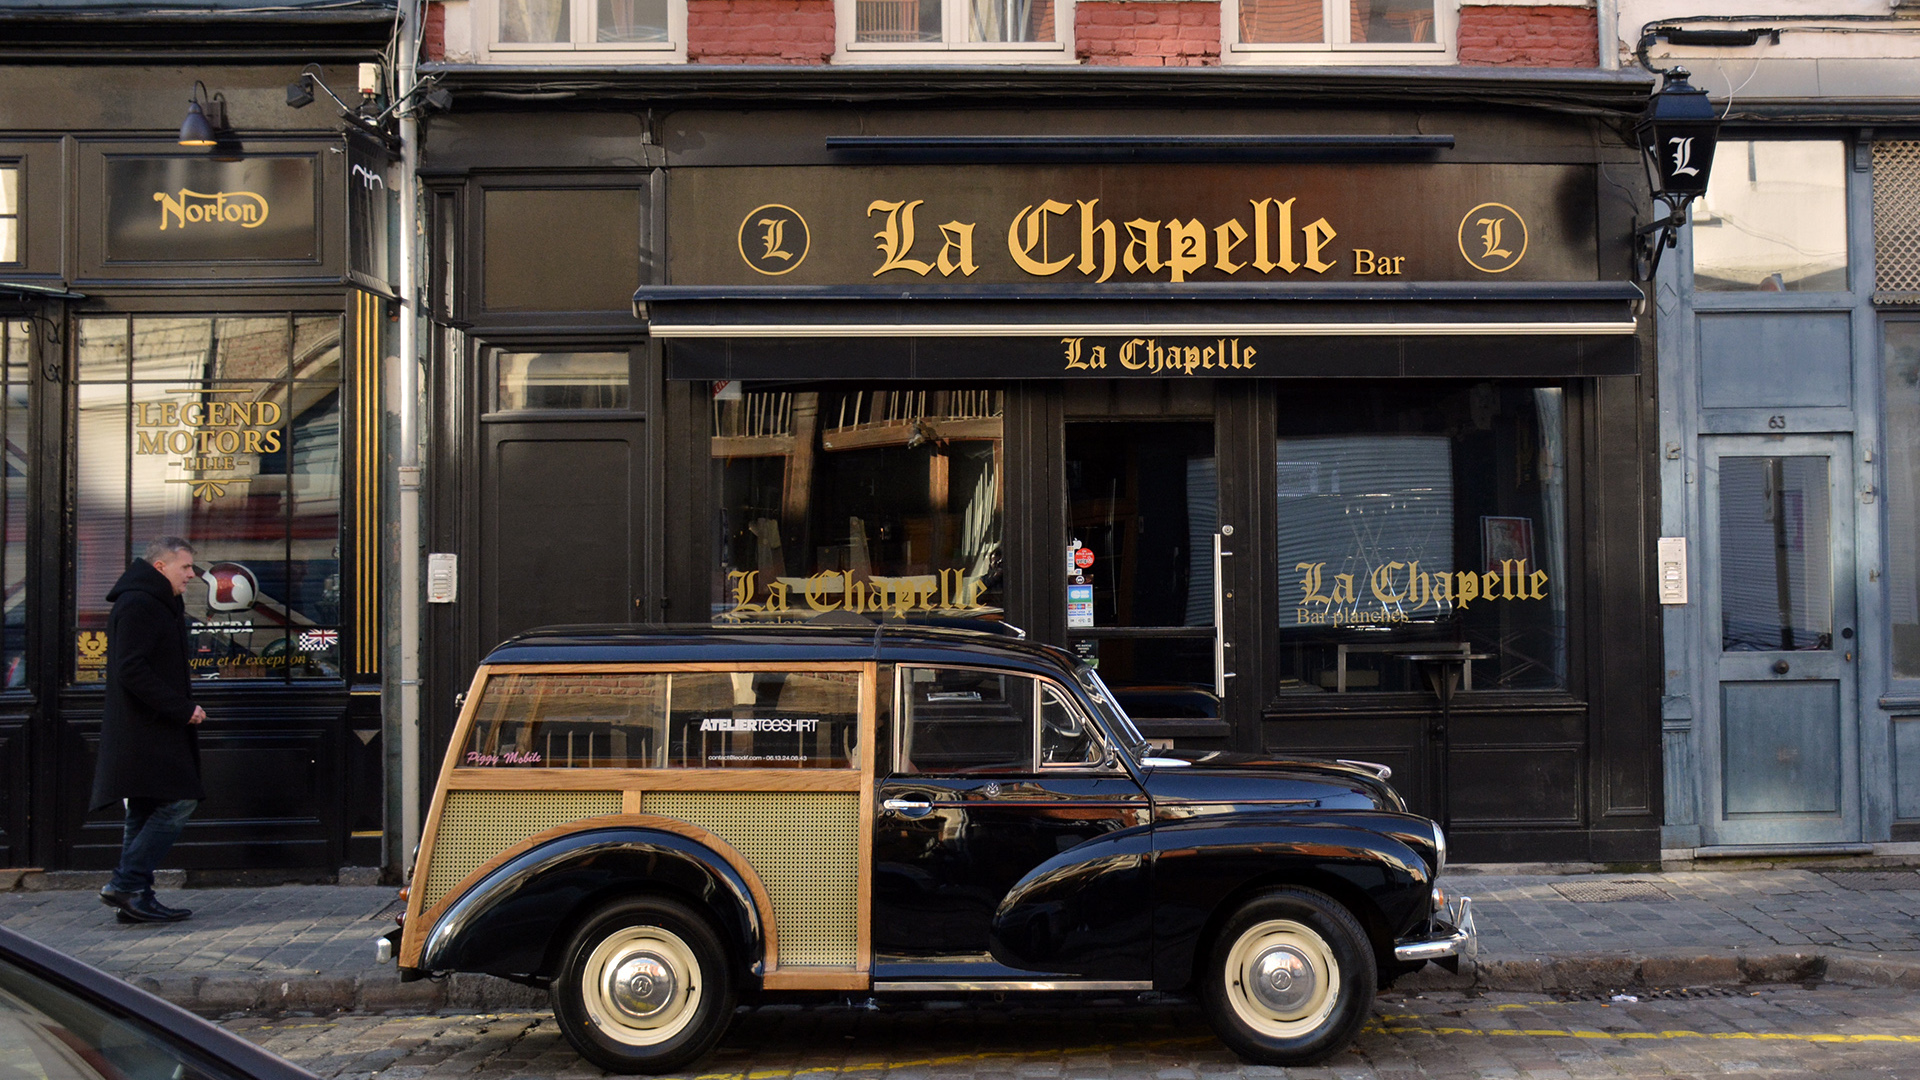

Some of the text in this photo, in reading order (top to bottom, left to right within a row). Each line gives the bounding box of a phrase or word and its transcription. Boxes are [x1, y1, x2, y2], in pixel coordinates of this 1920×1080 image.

[1669, 137, 1699, 176] L
[153, 188, 269, 231] Norton
[758, 219, 794, 261] L
[867, 197, 1405, 284] La Chapelle Bar
[1476, 218, 1513, 259] L
[1061, 337, 1257, 375] La Chapelle
[136, 401, 282, 427] LEGEND
[1768, 415, 1785, 429] 63
[136, 429, 282, 454] MOTORS
[728, 568, 988, 619] La Chapelle
[1295, 558, 1549, 610] La Chapelle
[191, 620, 254, 635] DAVIDA
[1296, 606, 1409, 628] Bar planches
[217, 655, 230, 666] et
[232, 653, 306, 668] d'excepton
[466, 751, 542, 766] Piggy Mobile
